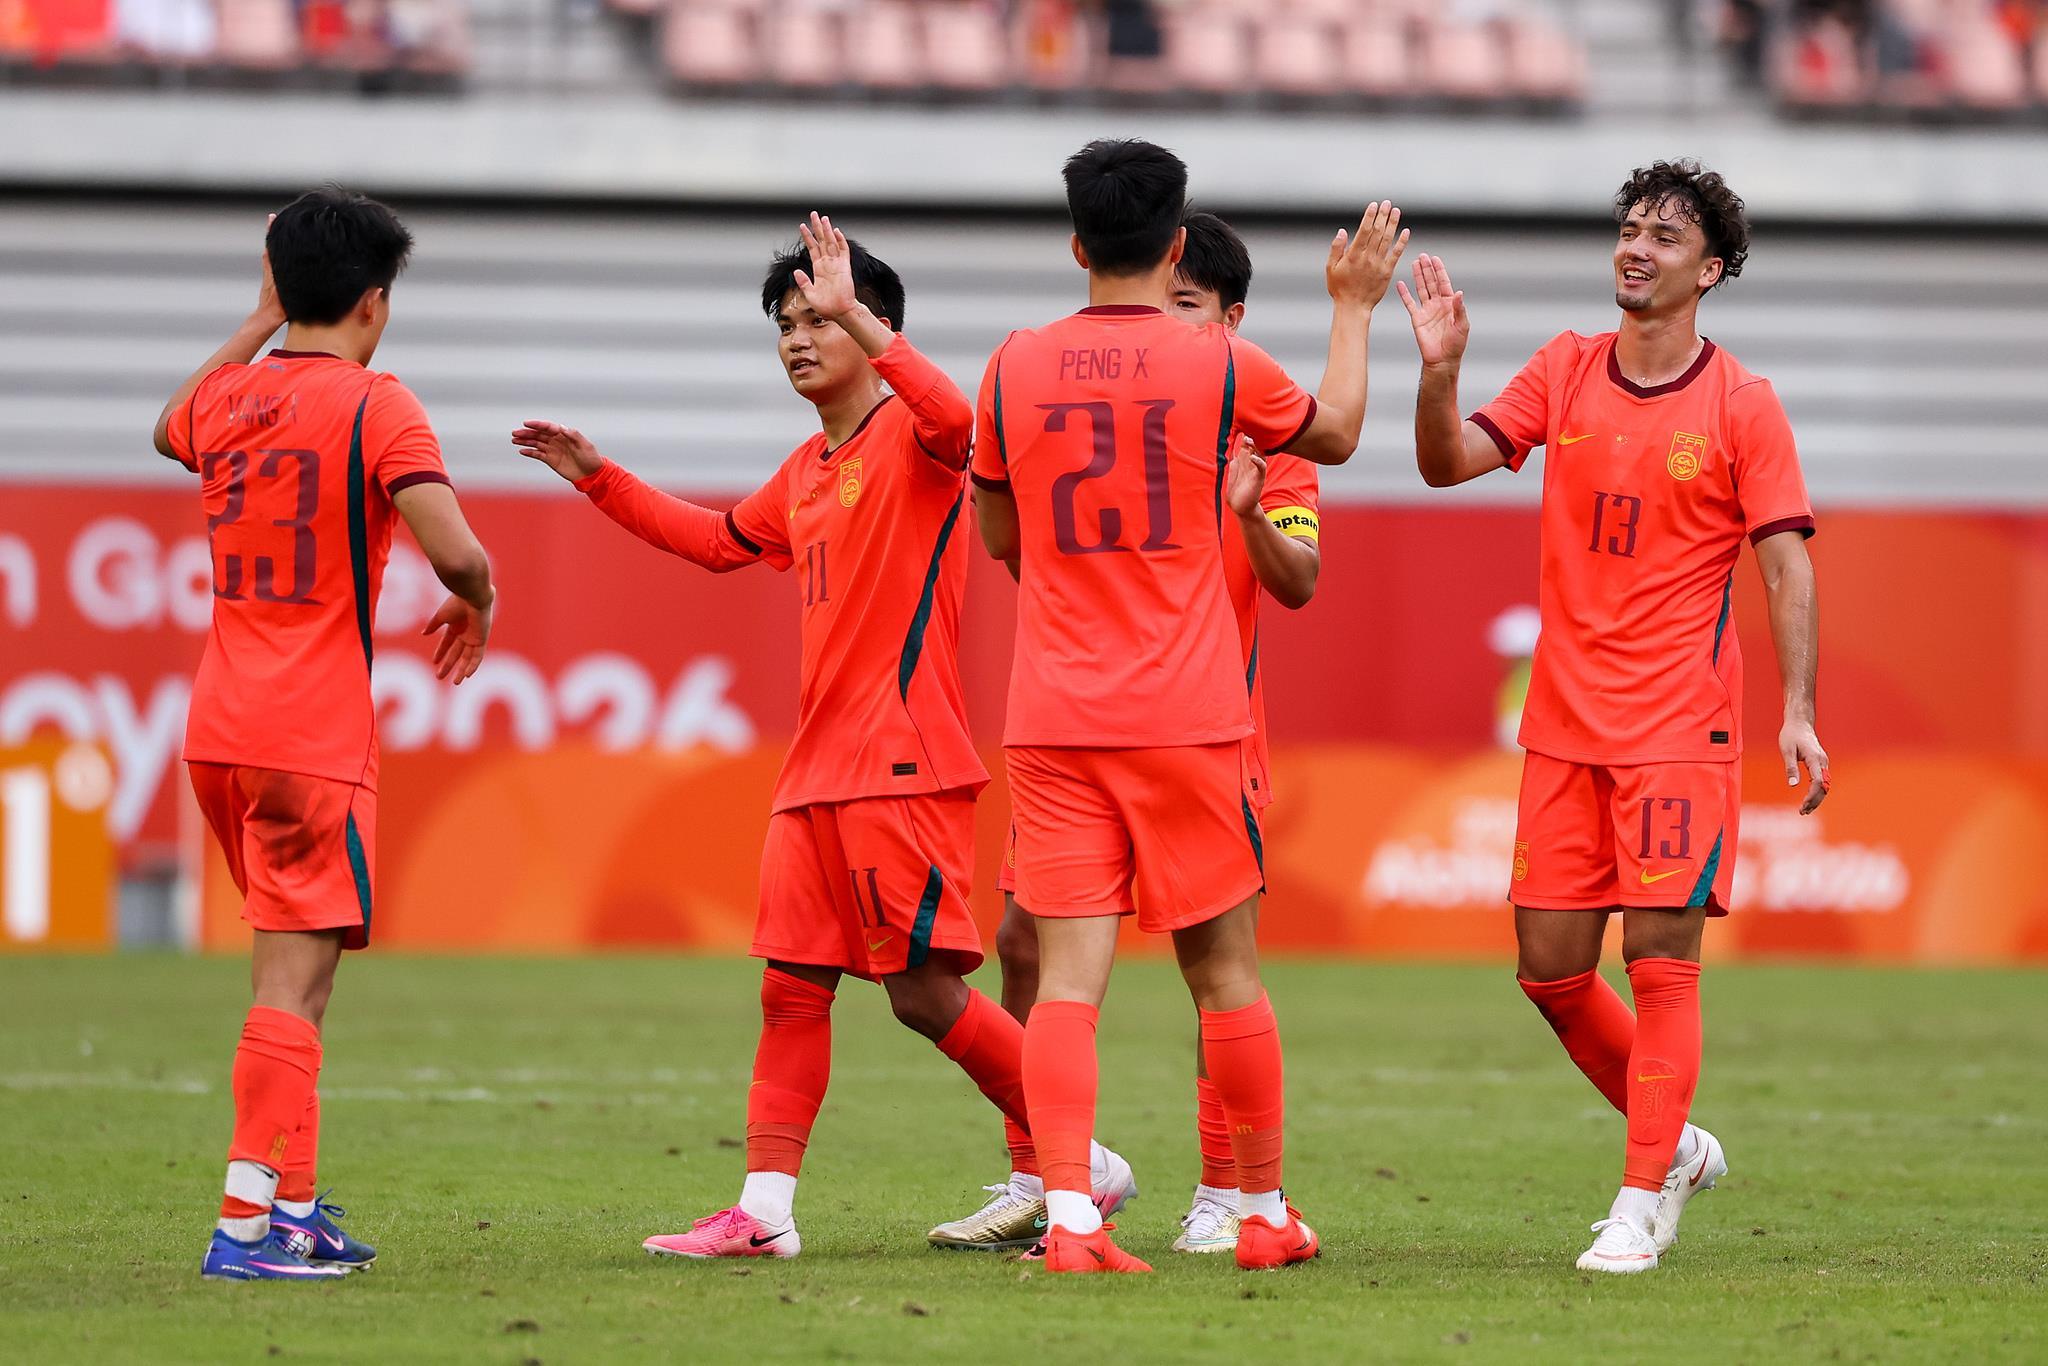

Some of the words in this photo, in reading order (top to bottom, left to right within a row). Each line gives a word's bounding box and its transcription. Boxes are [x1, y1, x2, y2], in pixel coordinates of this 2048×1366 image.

[1059, 348, 1122, 381] PENG
[1132, 348, 1150, 379] X
[1034, 399, 1183, 556] 21
[200, 448, 325, 606] 23
[1272, 514, 1318, 532] aptain
[1588, 490, 1642, 559] 13
[806, 541, 830, 607] 11
[1638, 797, 1693, 859] 13
[848, 867, 894, 929] 11
